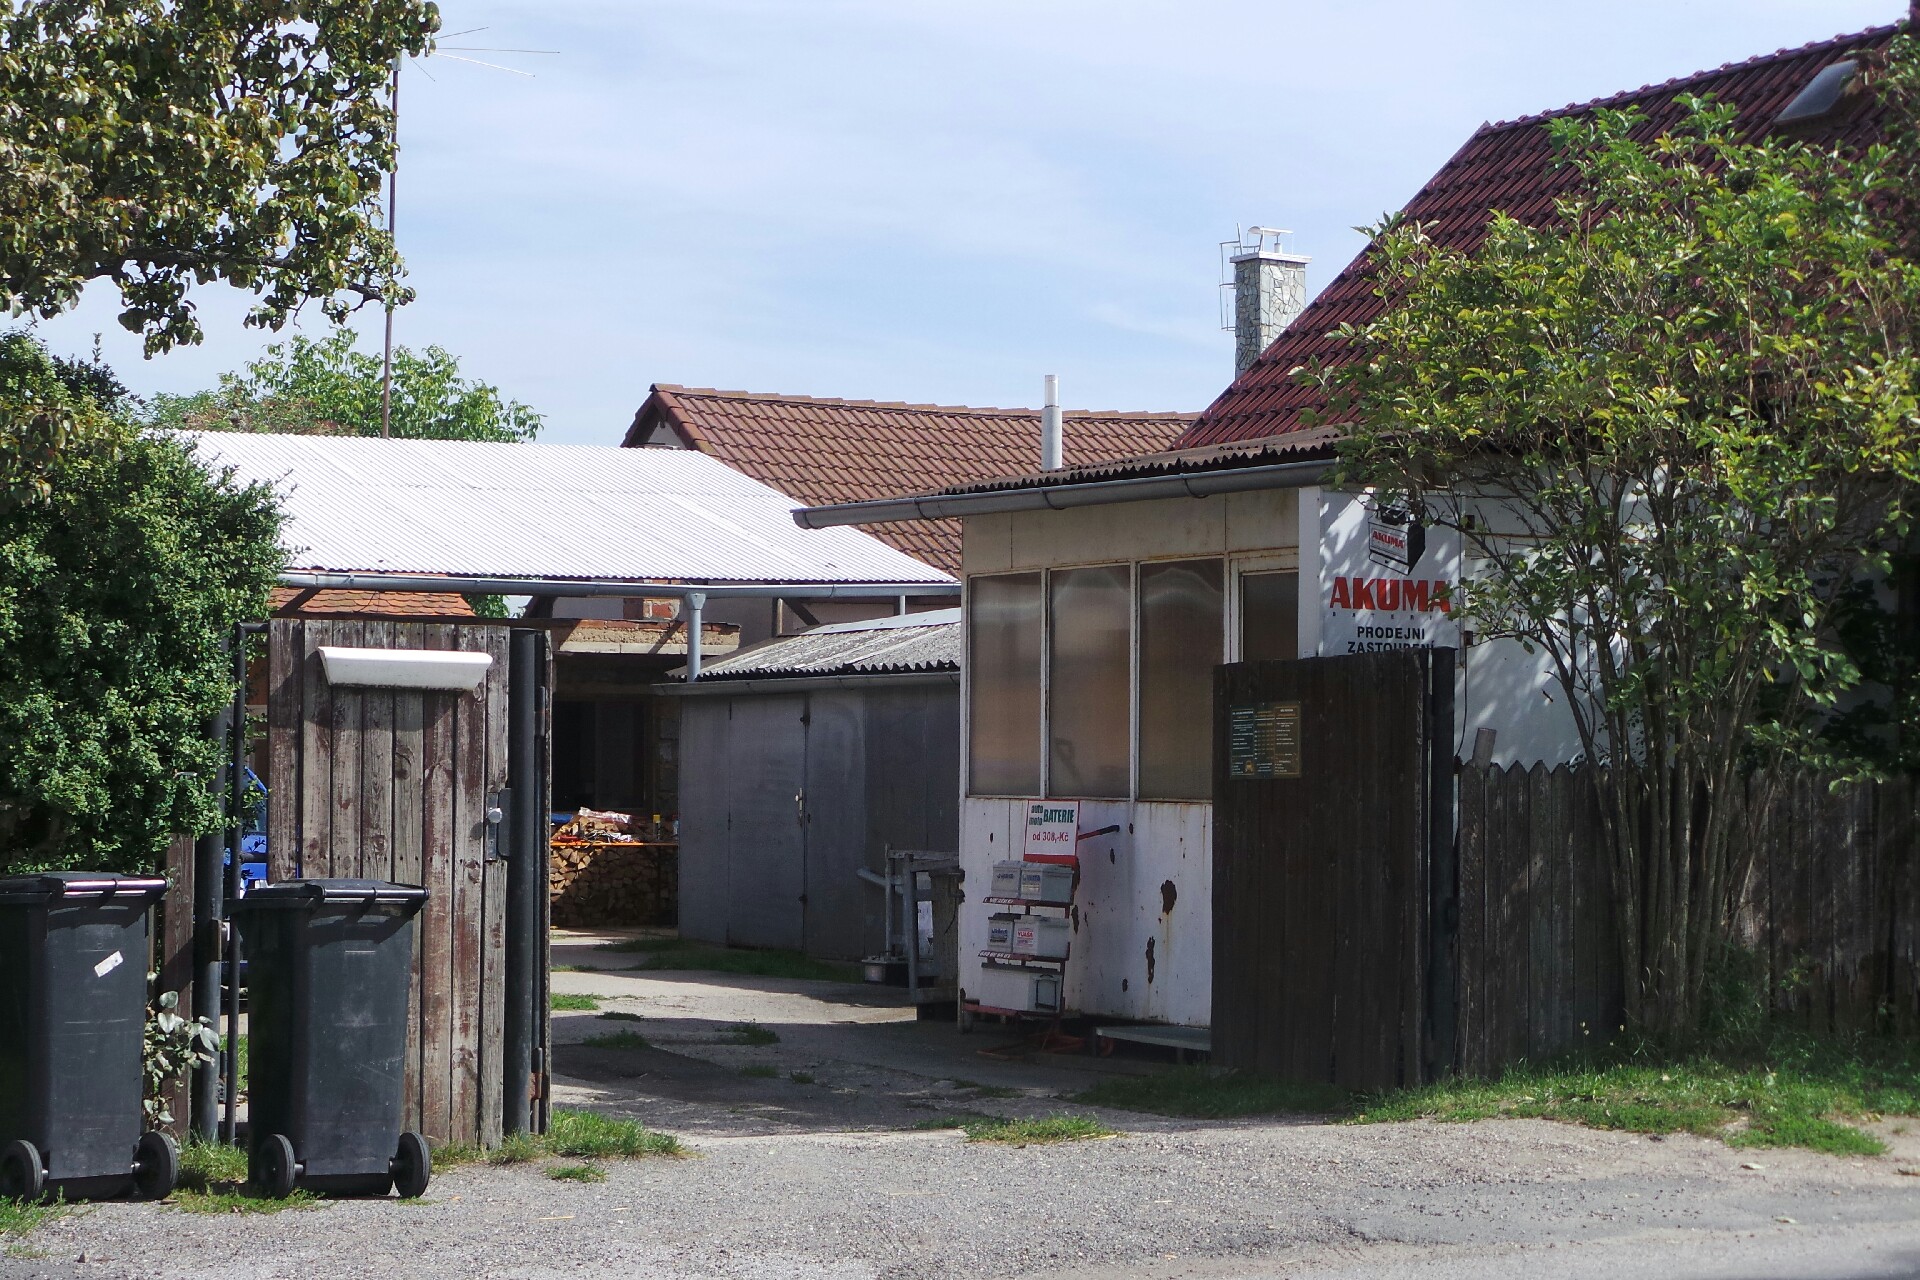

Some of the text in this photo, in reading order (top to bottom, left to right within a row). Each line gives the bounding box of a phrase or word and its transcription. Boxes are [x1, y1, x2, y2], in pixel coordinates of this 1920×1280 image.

[1372, 530, 1405, 549] AKUMA
[1329, 576, 1452, 613] AKUMA
[1332, 611, 1433, 620] BATERI
[1357, 626, 1425, 640] PRODEJNI
[1031, 804, 1044, 814] auto
[1028, 816, 1043, 826] moto
[1043, 809, 1075, 823] BATERIE
[1032, 831, 1041, 841] od
